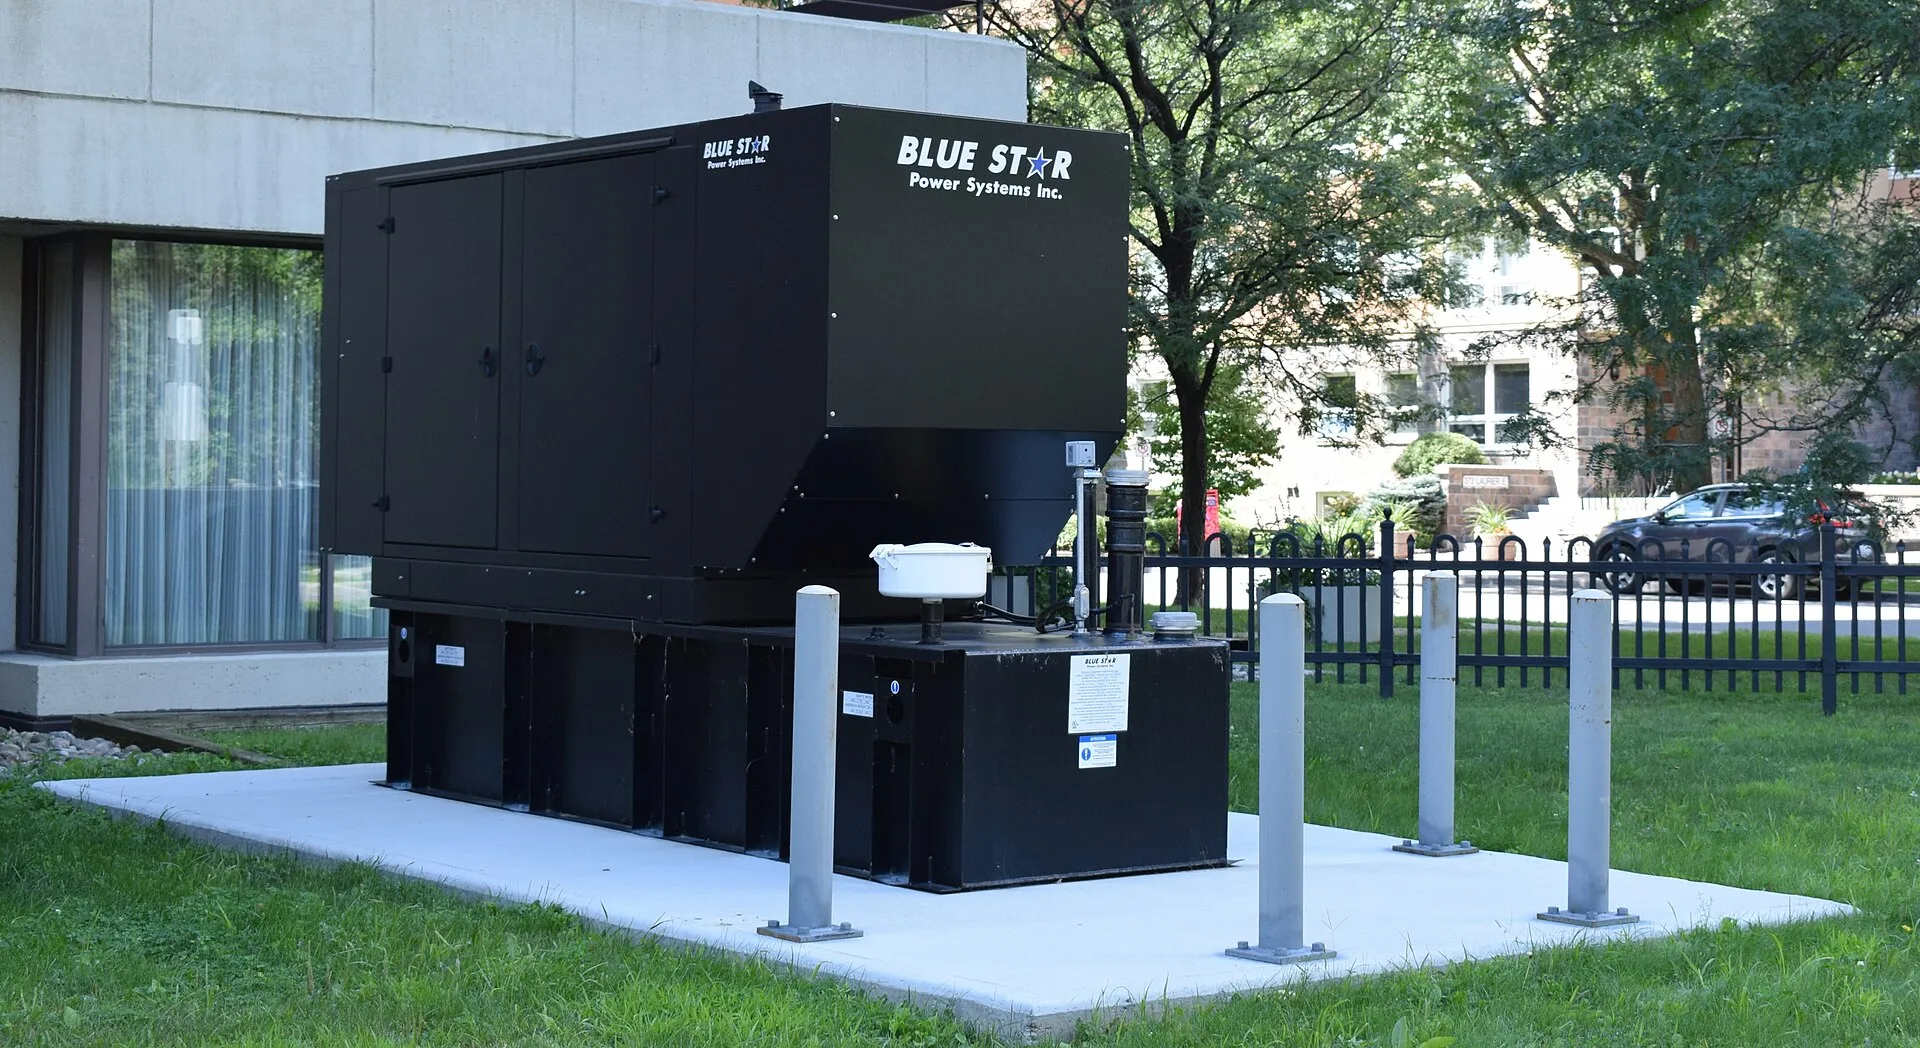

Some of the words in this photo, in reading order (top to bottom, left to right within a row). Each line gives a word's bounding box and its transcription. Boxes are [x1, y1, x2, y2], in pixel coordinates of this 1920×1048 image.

[703, 140, 734, 158] BLUE
[897, 135, 979, 171] BLUE
[707, 160, 727, 169] Power
[728, 158, 753, 168] Systems
[755, 155, 766, 164] Inc.
[909, 172, 960, 191] Power
[966, 176, 1031, 197] Systems
[1037, 183, 1063, 200] Inc.
